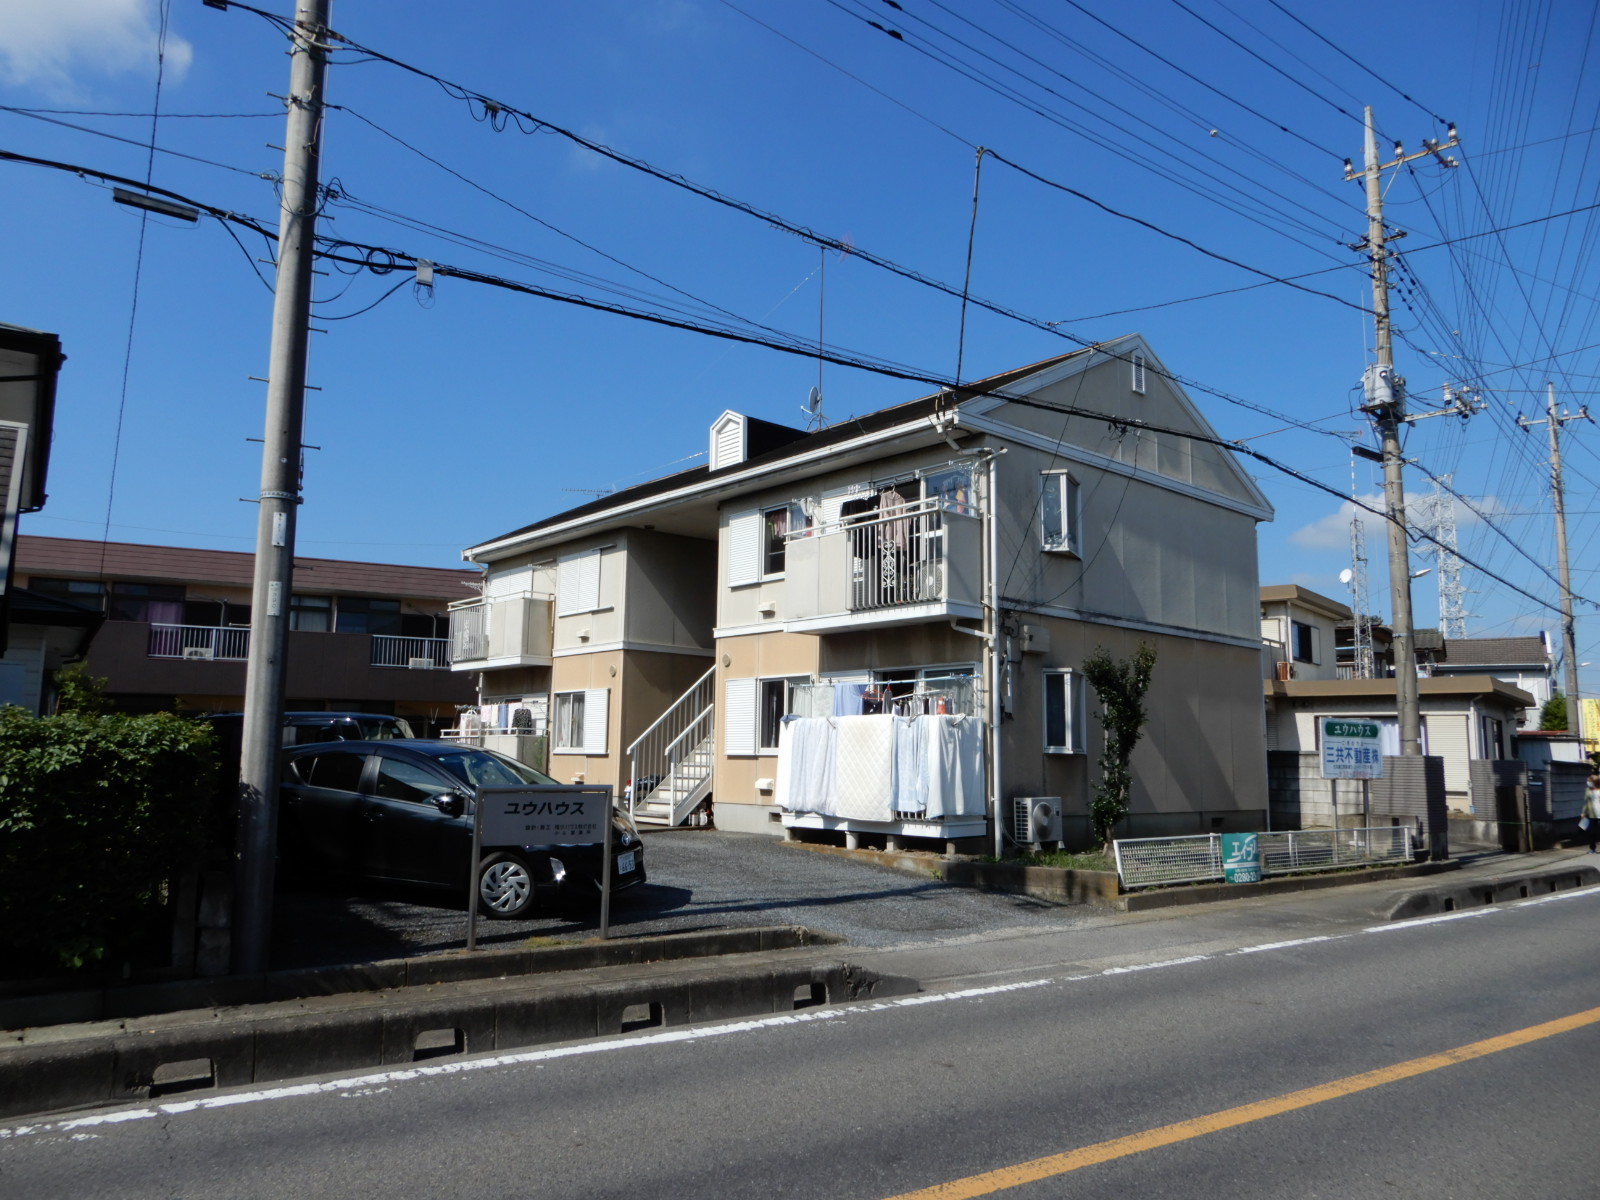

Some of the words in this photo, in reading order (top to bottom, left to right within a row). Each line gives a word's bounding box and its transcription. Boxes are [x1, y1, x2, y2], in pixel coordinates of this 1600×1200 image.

[1334, 724, 1371, 736] ユウハウス
[503, 801, 585, 816] ユウハウス
